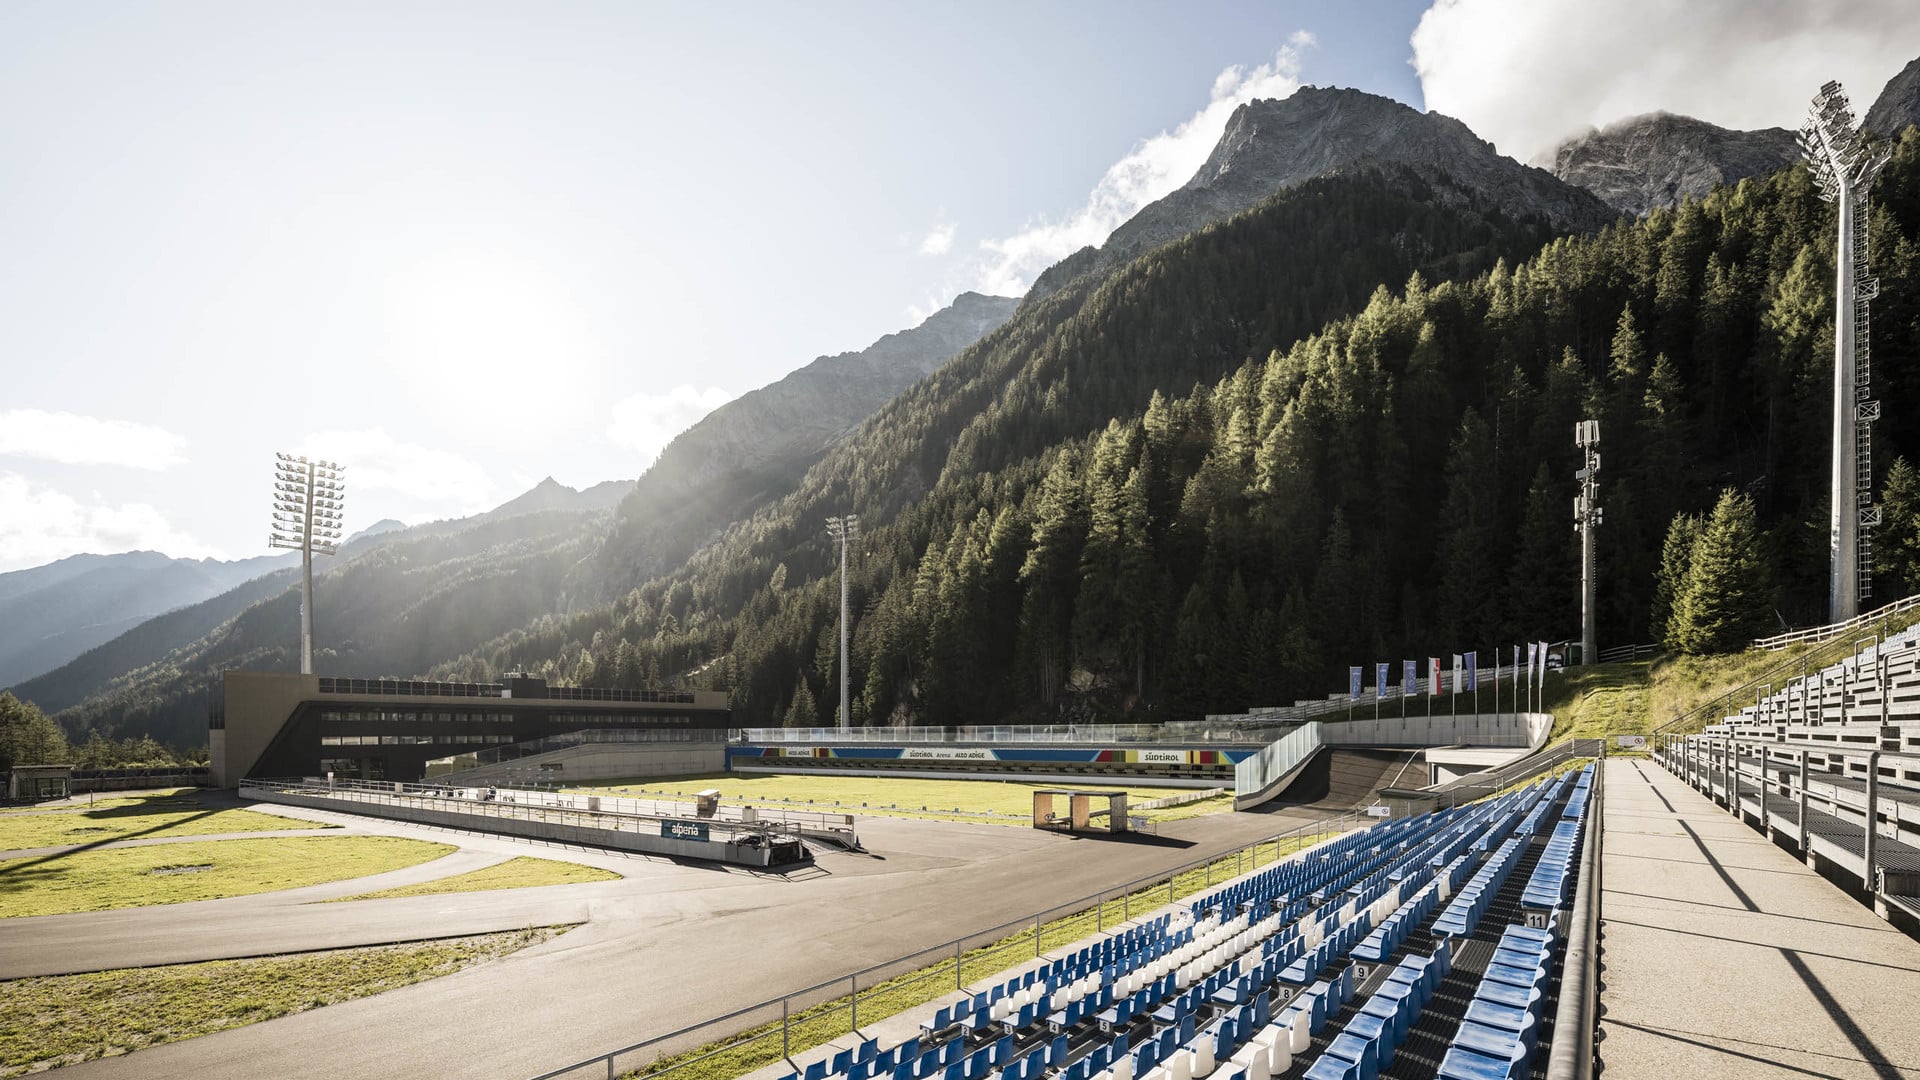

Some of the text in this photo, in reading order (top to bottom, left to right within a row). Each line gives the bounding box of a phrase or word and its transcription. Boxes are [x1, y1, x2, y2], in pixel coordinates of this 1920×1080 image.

[672, 822, 699, 837] alperia
[1530, 915, 1542, 927] 11
[1358, 967, 1364, 977] 9
[1284, 989, 1289, 998] 8
[1217, 1009, 1222, 1018] 7
[1102, 1022, 1107, 1030] 5
